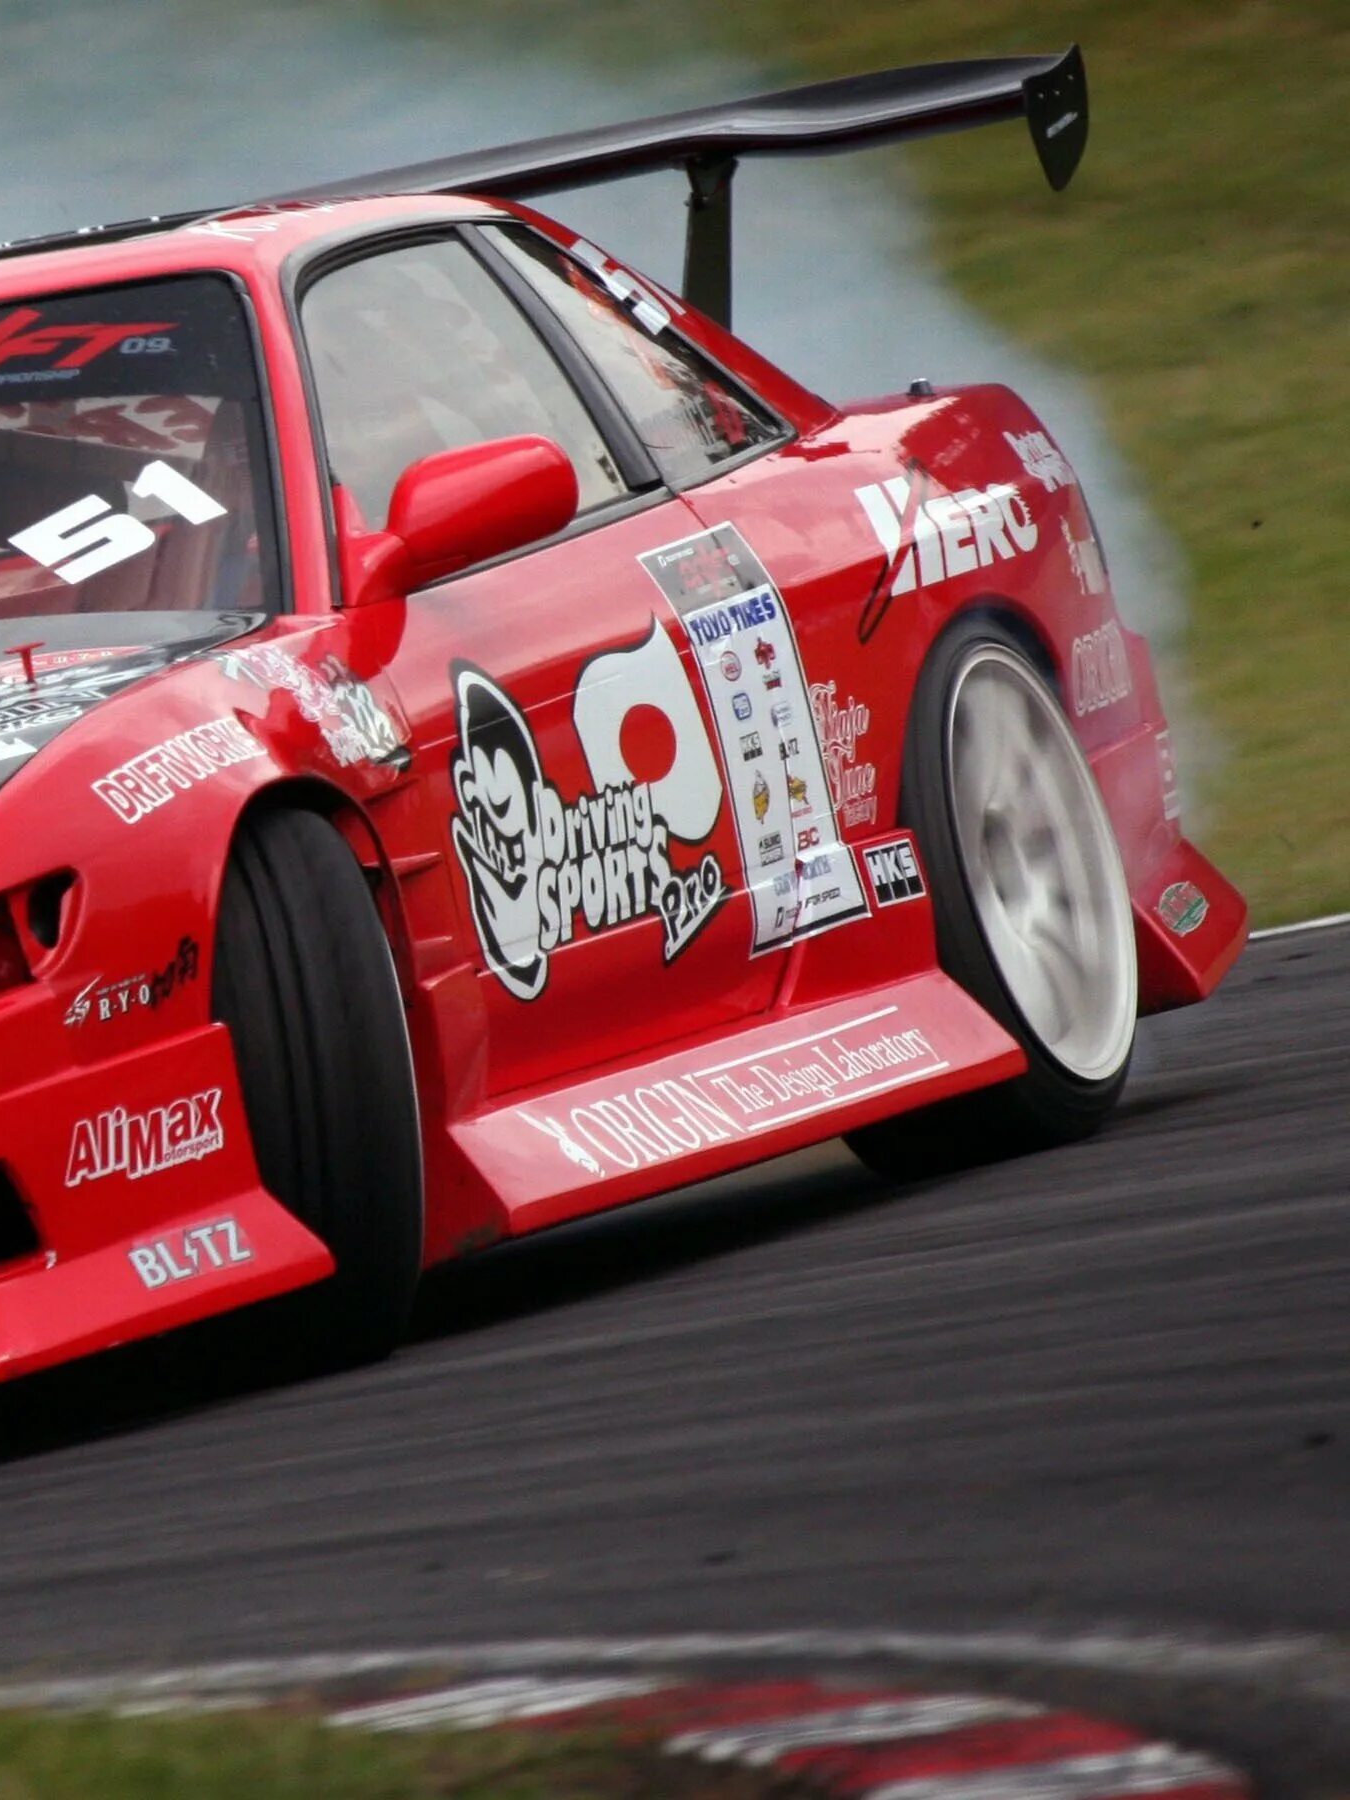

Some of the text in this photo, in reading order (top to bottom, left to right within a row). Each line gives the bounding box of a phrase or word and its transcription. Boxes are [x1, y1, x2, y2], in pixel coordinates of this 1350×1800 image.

[8, 459, 228, 584] 51
[689, 592, 777, 646] TOYO TIRES
[90, 715, 268, 825] DRIFTWORKS
[534, 779, 652, 871] Driving
[867, 845, 920, 886] HKS
[538, 823, 672, 952] SPORTS
[570, 1028, 939, 1169] ORIGIN The Design Laboratory
[128, 1218, 252, 1288] BLITZ
